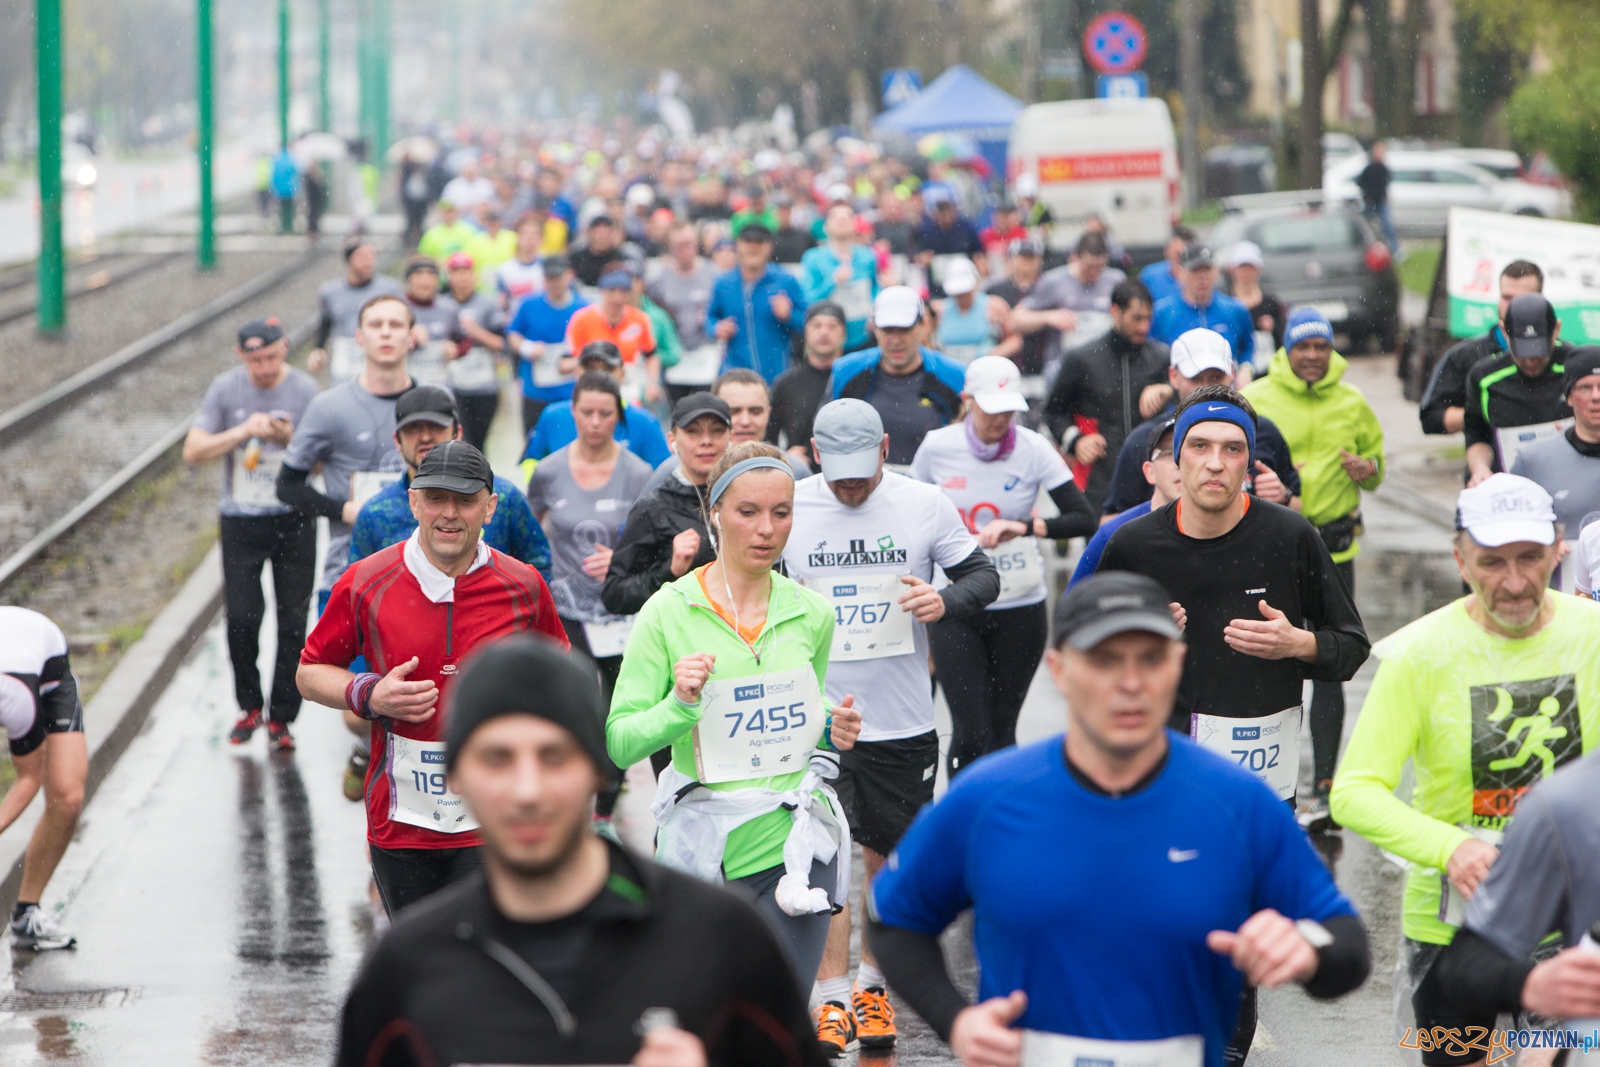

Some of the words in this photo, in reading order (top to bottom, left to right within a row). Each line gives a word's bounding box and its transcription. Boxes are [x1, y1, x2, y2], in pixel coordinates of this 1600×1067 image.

[810, 553, 835, 567] KB
[837, 550, 906, 566] ZIEMEK
[835, 601, 891, 626] 4767
[848, 627, 872, 635] Marcin
[724, 702, 806, 738] 7455
[749, 735, 792, 747] Agnieszka
[1231, 744, 1280, 772] 702
[412, 770, 447, 796] 119
